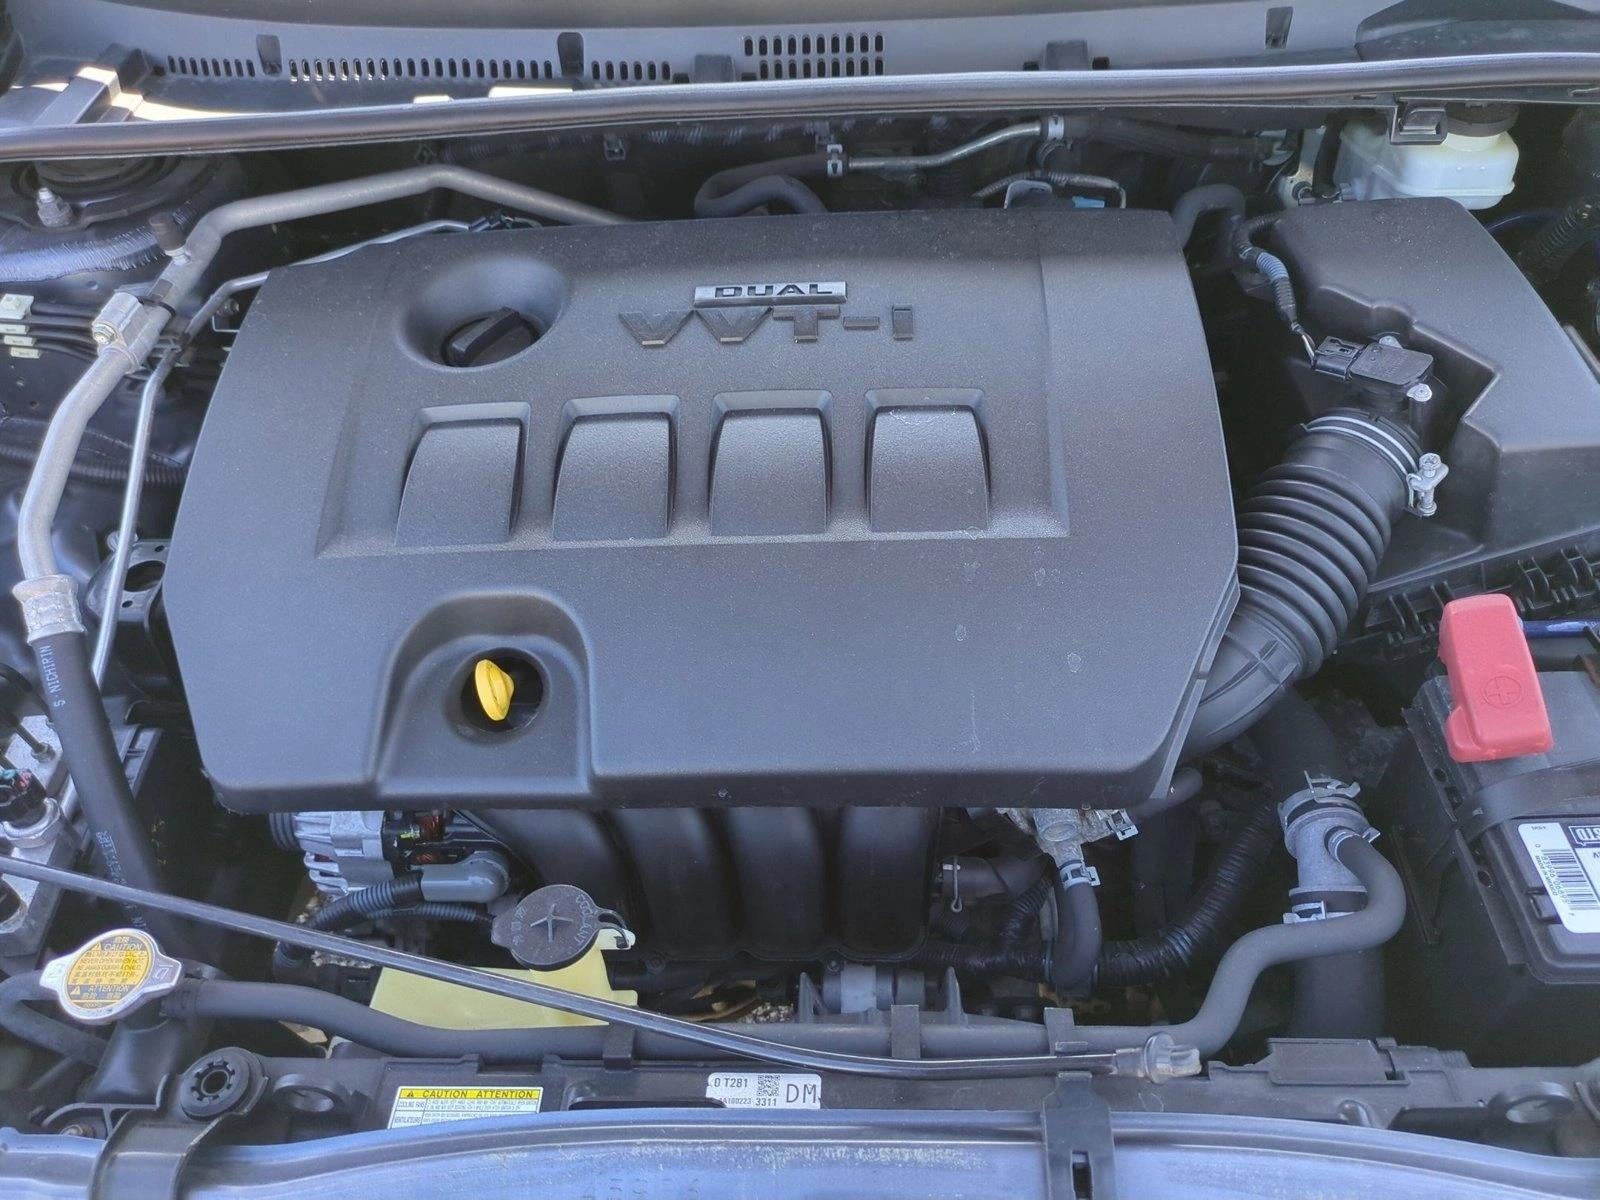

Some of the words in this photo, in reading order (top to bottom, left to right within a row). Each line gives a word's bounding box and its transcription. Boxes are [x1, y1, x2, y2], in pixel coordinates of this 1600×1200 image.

[714, 282, 833, 299] DUAL
[39, 645, 62, 693] NICHIRIN
[104, 943, 143, 951] CAUTION
[88, 984, 129, 992] ATTENTION
[422, 1089, 468, 1098] CAUTION
[475, 1089, 533, 1098] ATTENTION
[786, 1083, 817, 1104] DM
[755, 1098, 777, 1107] 3311
